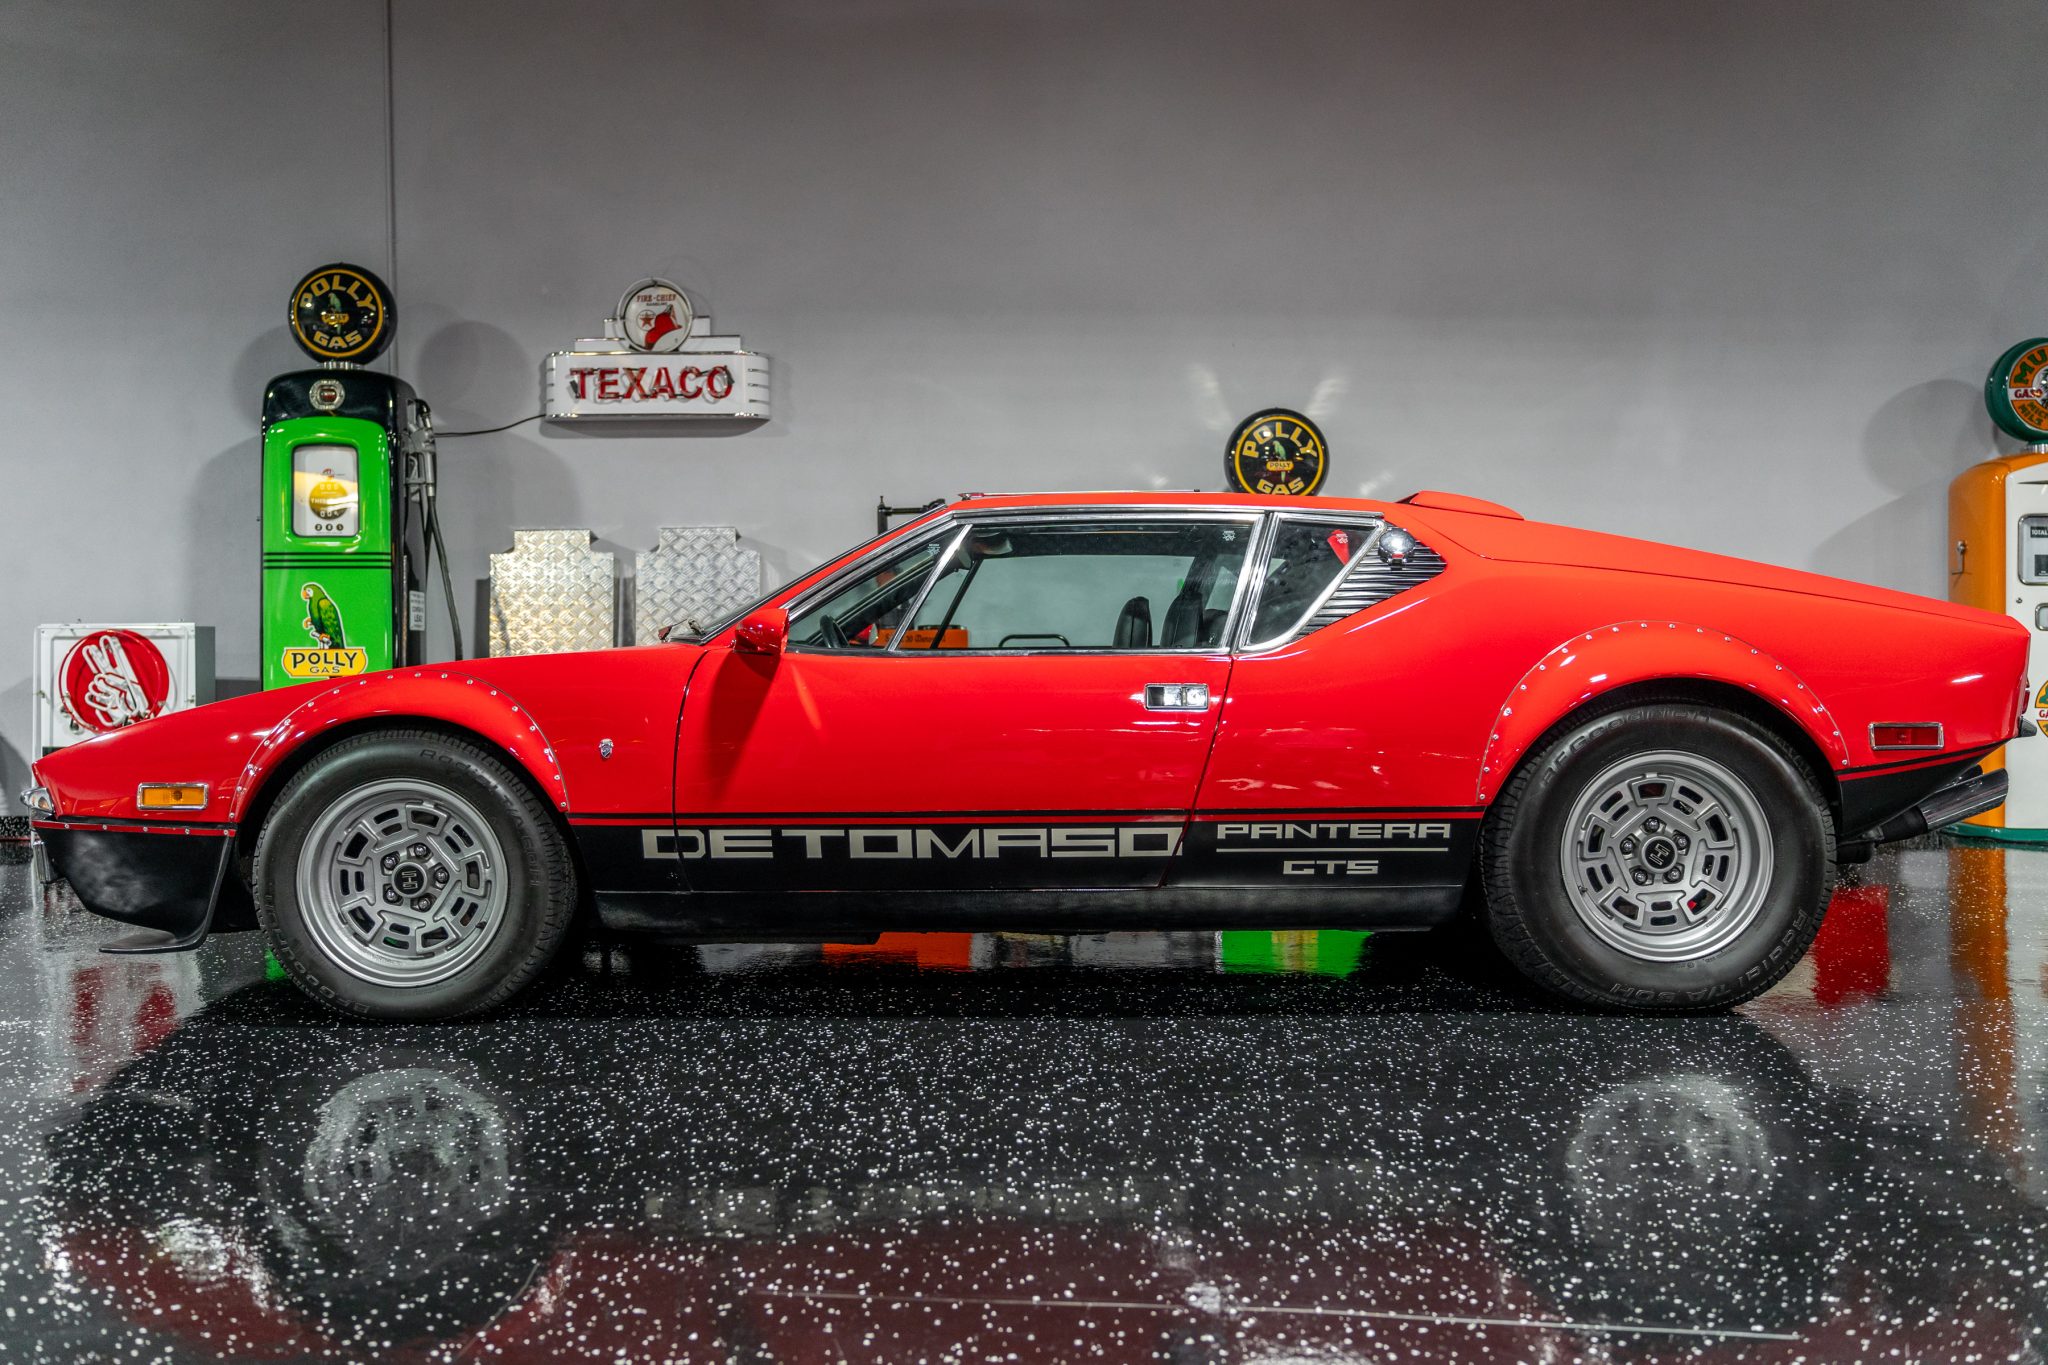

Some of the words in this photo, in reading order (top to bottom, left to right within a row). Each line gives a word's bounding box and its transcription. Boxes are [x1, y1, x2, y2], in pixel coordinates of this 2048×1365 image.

[300, 275, 376, 311] POLLY
[313, 330, 362, 348] GAS
[569, 365, 734, 400] TEXACO
[1242, 422, 1318, 458] POLLY
[1256, 477, 1305, 495] GAS
[291, 652, 358, 669] POLLY
[309, 666, 340, 674] GAS
[1217, 823, 1451, 839] PANTERA
[1283, 860, 1379, 875] GTS
[1738, 908, 1810, 989] Radial
